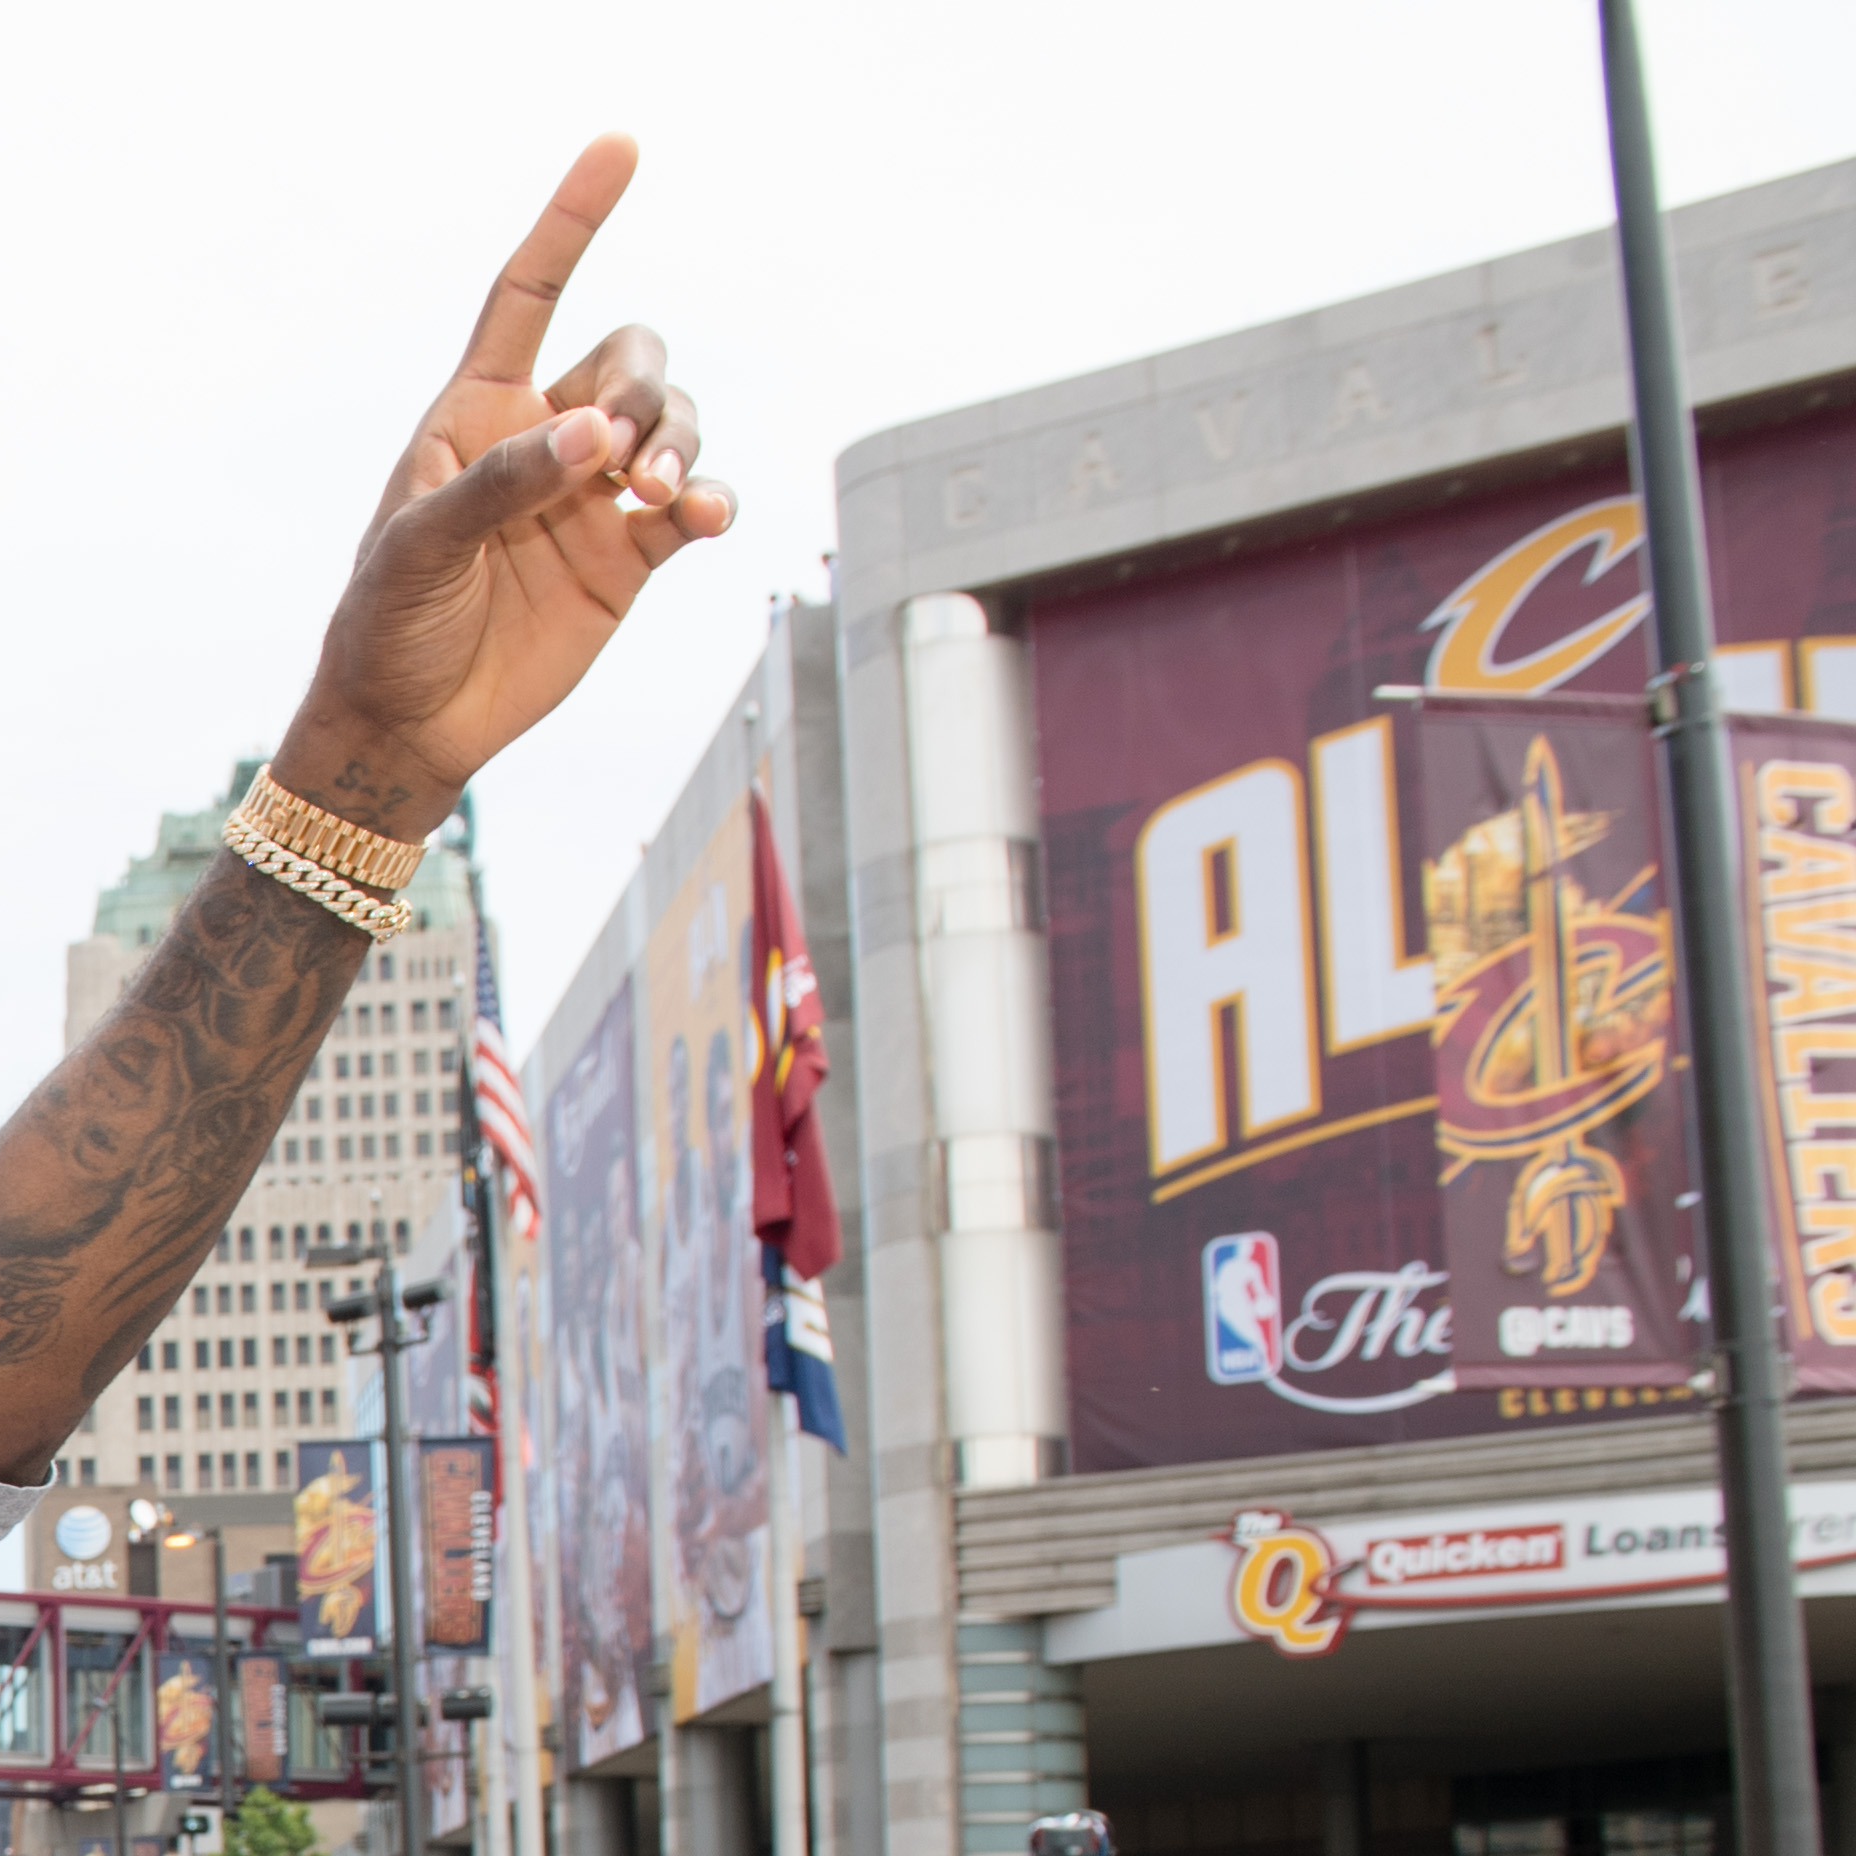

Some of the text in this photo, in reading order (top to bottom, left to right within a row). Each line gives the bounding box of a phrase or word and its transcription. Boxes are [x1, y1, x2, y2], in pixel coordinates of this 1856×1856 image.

[943, 238, 1811, 530] CAVALE
[1136, 713, 1448, 1182] AL
[1497, 1304, 1634, 1357] @CAVS
[1368, 1531, 1565, 1583] Quicken
